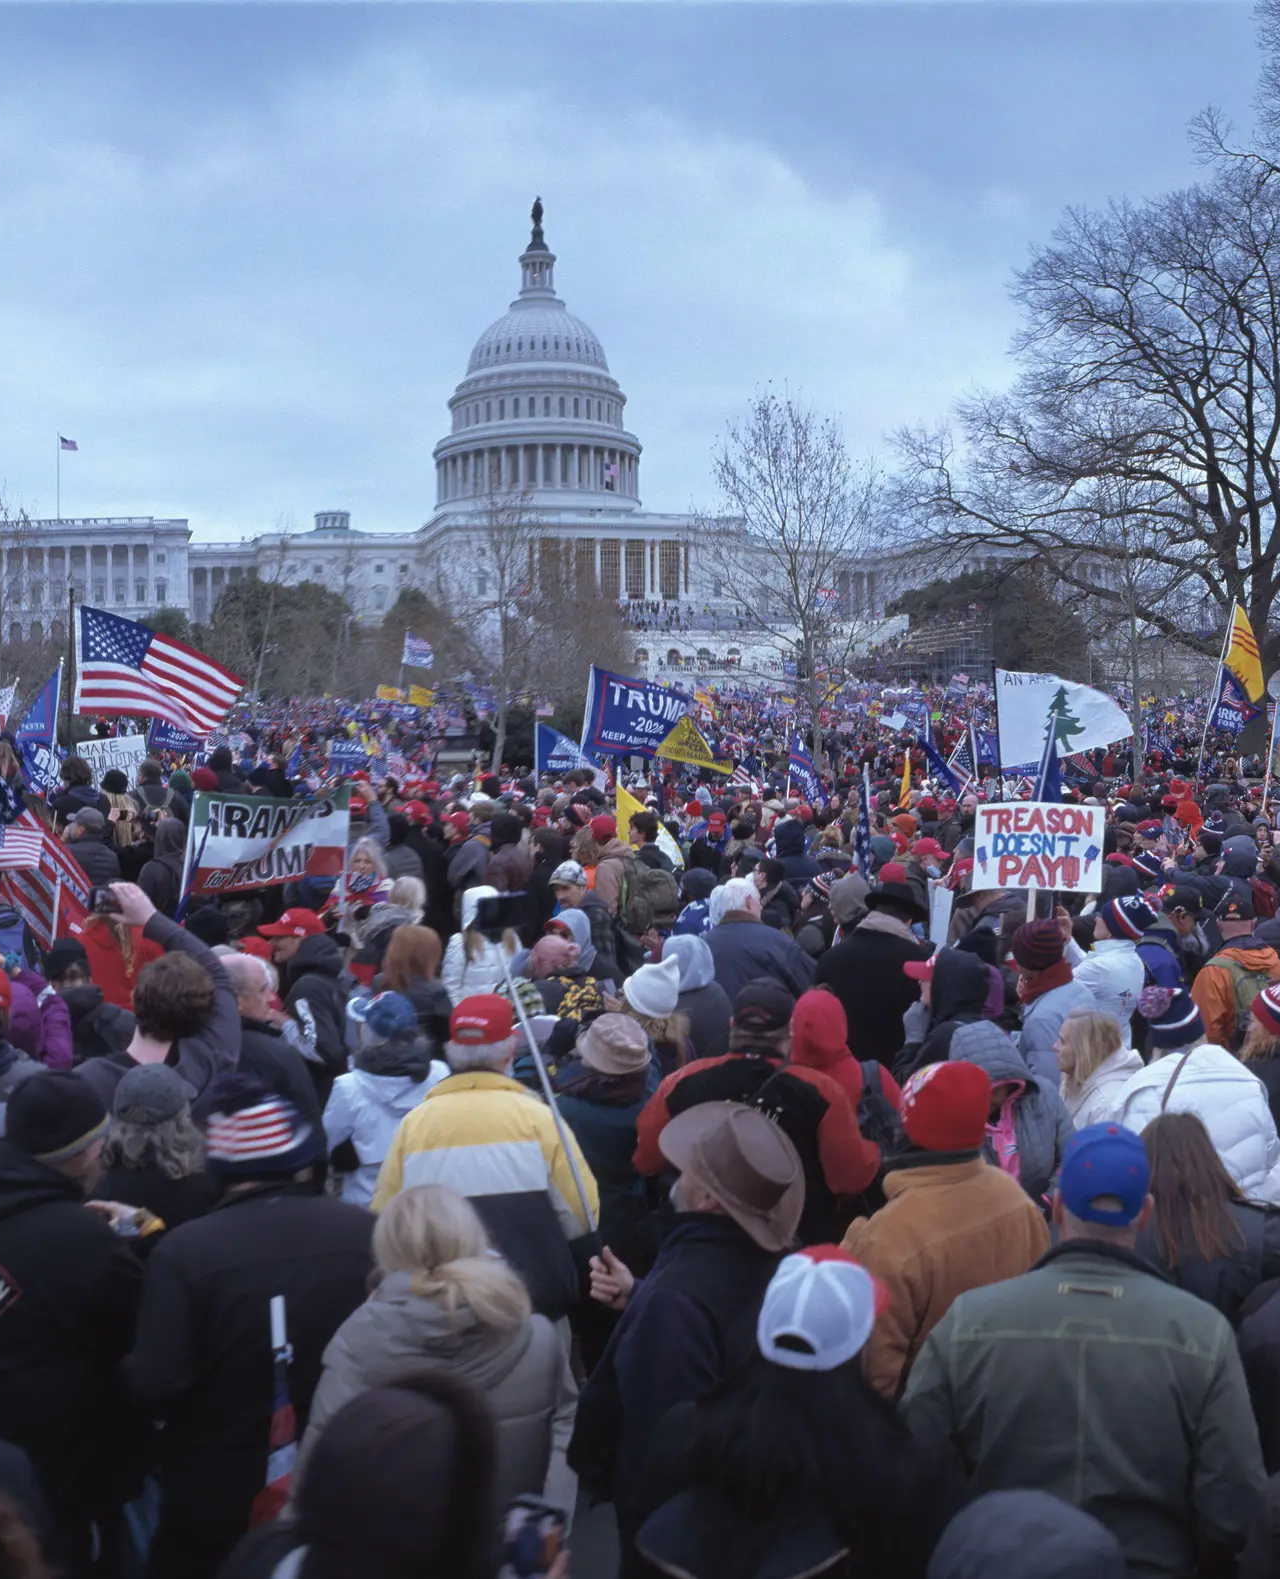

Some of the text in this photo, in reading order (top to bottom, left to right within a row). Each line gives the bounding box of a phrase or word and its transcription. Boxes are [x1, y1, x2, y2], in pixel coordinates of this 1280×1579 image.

[1004, 673, 1023, 686] AN
[609, 681, 687, 724] TRUMP
[1218, 719, 1235, 728] FOR
[601, 729, 626, 741] KEEP
[78, 740, 120, 758] MAKE
[789, 763, 800, 774] NO
[981, 808, 1094, 837] TREASON
[203, 870, 228, 889] for
